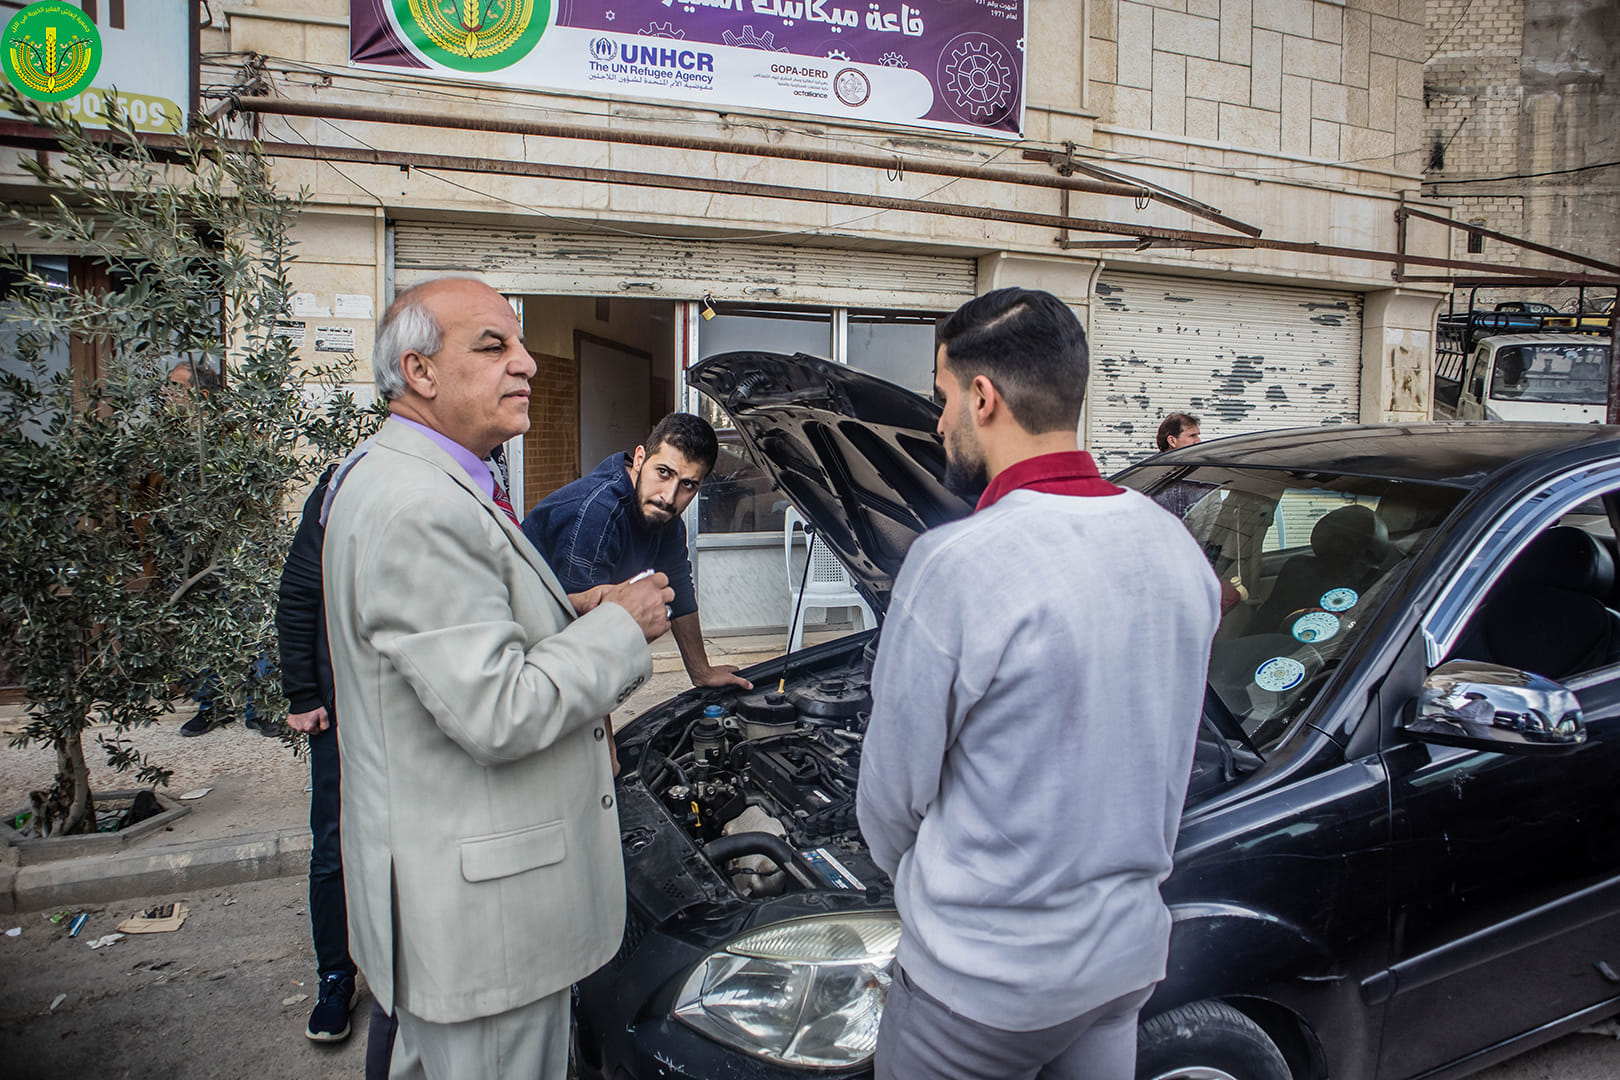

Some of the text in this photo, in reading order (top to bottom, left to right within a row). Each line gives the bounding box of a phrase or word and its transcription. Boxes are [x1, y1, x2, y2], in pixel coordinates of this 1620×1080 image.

[865, 3, 924, 37] قاعة
[620, 43, 714, 73] UNHCR
[770, 63, 829, 79] GOPA-DERD
[589, 60, 714, 85] The UN Refugee Agency
